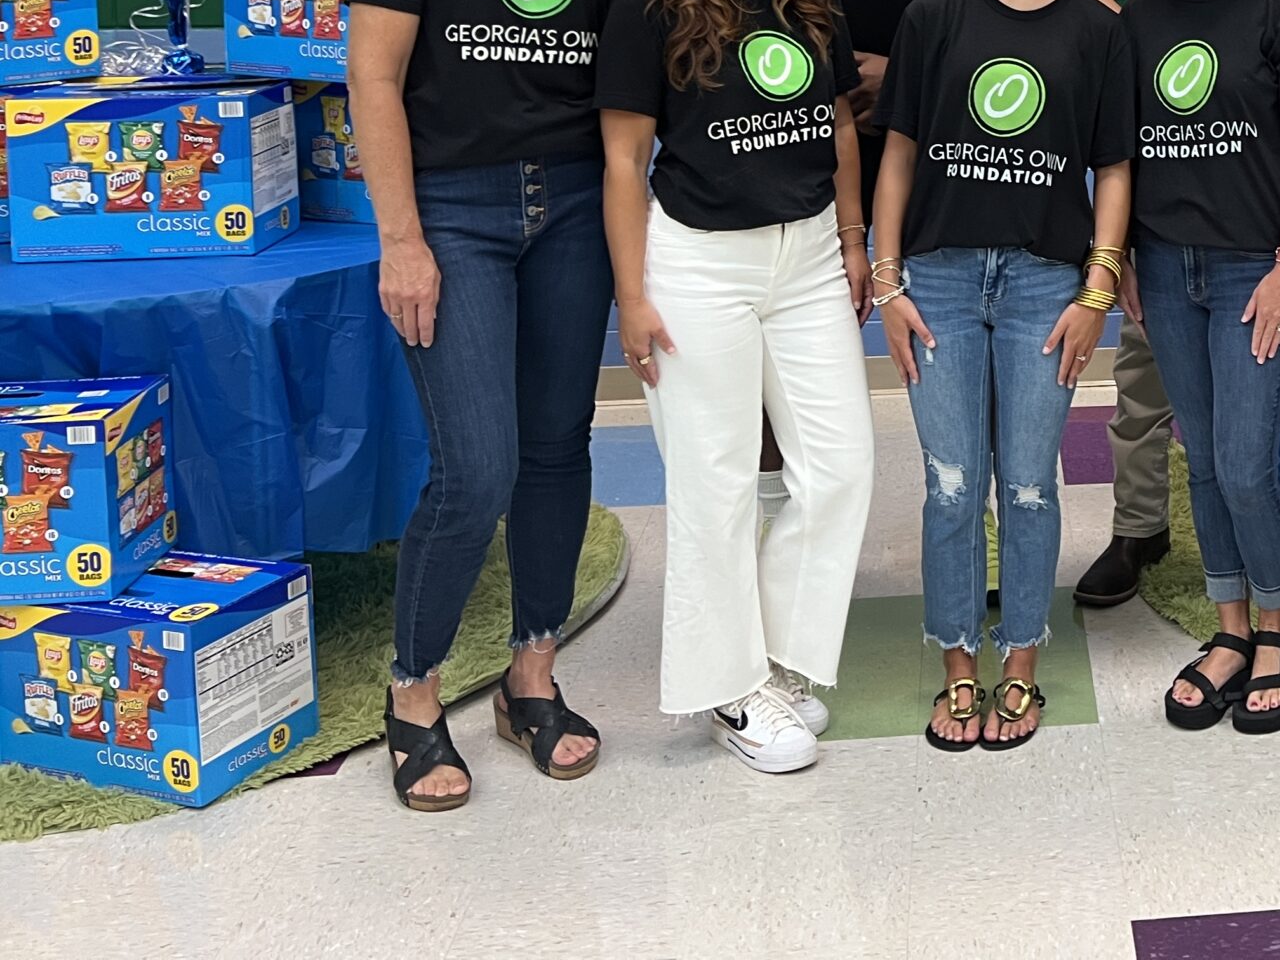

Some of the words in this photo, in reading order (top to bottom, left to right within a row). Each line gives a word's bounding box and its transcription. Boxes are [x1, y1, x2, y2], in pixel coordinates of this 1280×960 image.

[445, 24, 557, 46] GEORGIA'S
[73, 37, 92, 54] 50
[461, 46, 592, 65] FOUNDATION
[707, 108, 808, 140] GEORGIA'S
[1140, 124, 1205, 142] ORGIA'S
[1210, 121, 1258, 138] OWN
[731, 125, 833, 155] FOUNDATIO
[1142, 141, 1242, 158] OUNDATION
[929, 143, 1024, 166] GEORGIA'S
[137, 214, 210, 232] classic
[225, 212, 246, 230] 50
[0, 556, 61, 576] assic
[78, 552, 101, 572] 50
[109, 597, 179, 613] classic
[97, 747, 160, 773] classic
[228, 742, 267, 772] classic
[171, 758, 190, 779] 50
